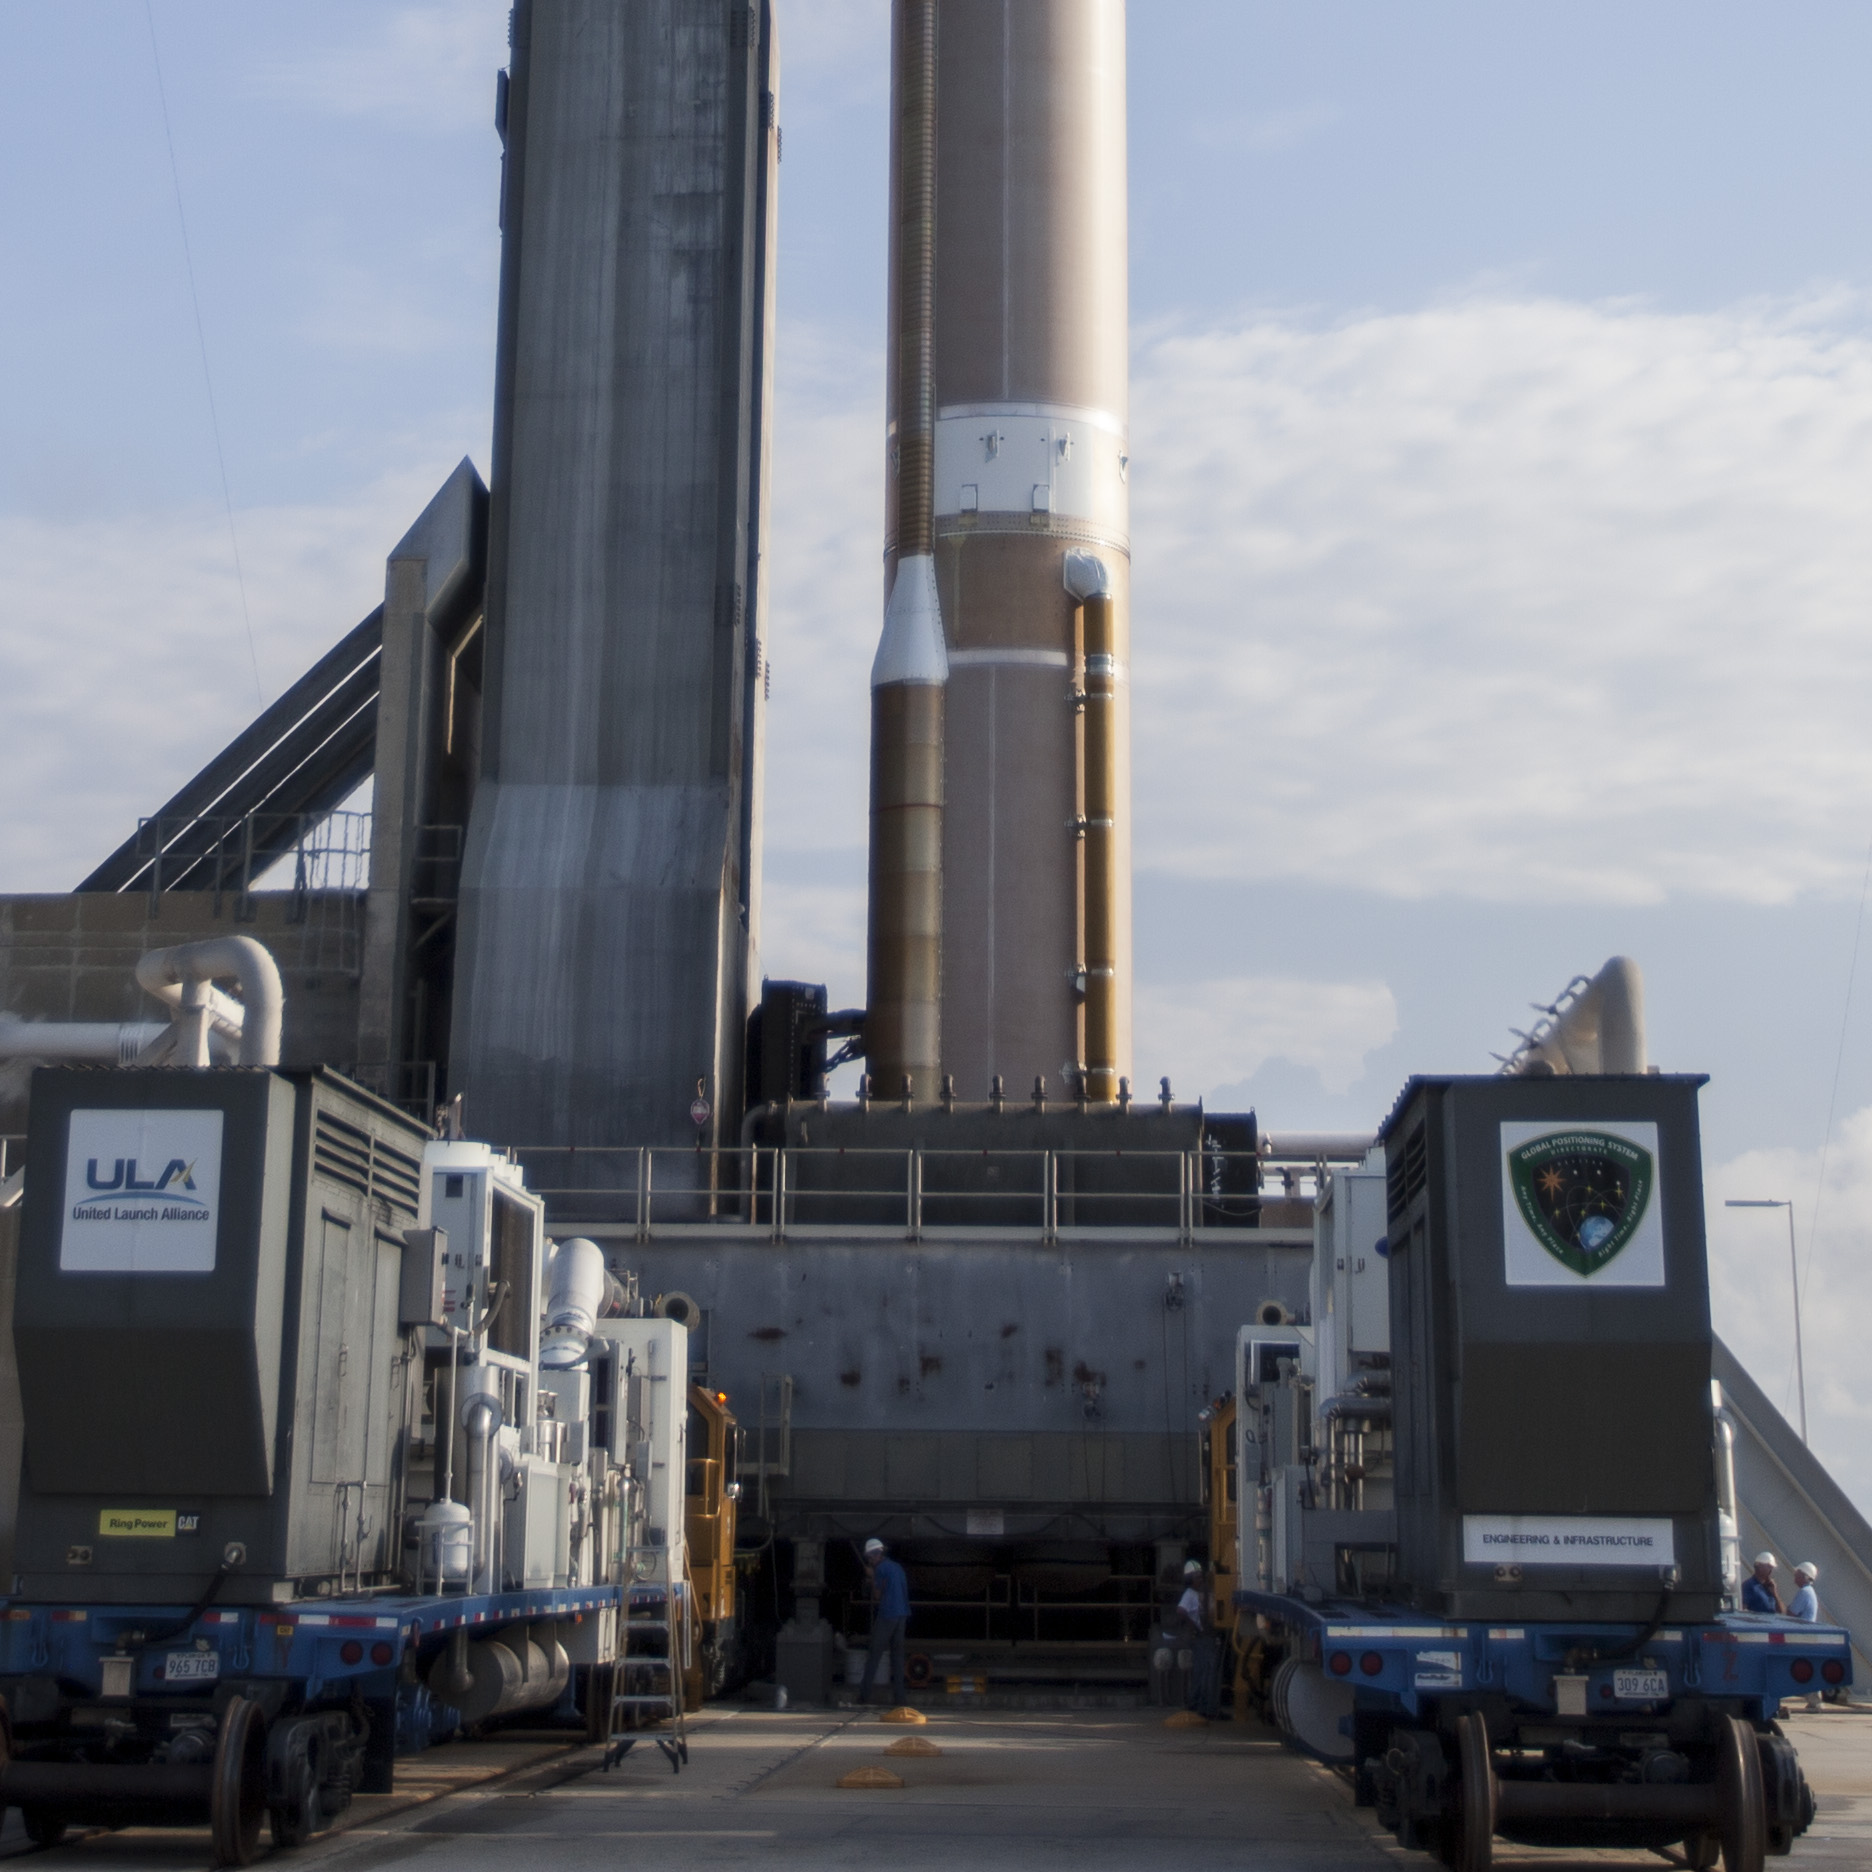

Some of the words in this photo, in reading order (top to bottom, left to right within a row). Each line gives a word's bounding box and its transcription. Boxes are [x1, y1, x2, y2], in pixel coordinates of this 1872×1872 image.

[1521, 1142, 1551, 1160] GLOBAL
[1552, 1136, 1605, 1147] POSITIONING
[1608, 1141, 1639, 1161] SYSTEM
[87, 1158, 198, 1190] ULA
[73, 1206, 111, 1220] United
[115, 1207, 158, 1221] Launch
[161, 1207, 210, 1222] Alliance
[110, 1519, 133, 1531] Ring
[134, 1519, 168, 1529] Power
[177, 1515, 200, 1530] CAT
[1483, 1534, 1550, 1545] ENGINEERING
[1553, 1535, 1561, 1545] &
[1563, 1535, 1654, 1547] INFRASTRUCTURE
[169, 1659, 190, 1674] 965
[195, 1658, 215, 1673] 7CB
[1617, 1677, 1639, 1691] 309
[1643, 1678, 1665, 1692] 6CA
